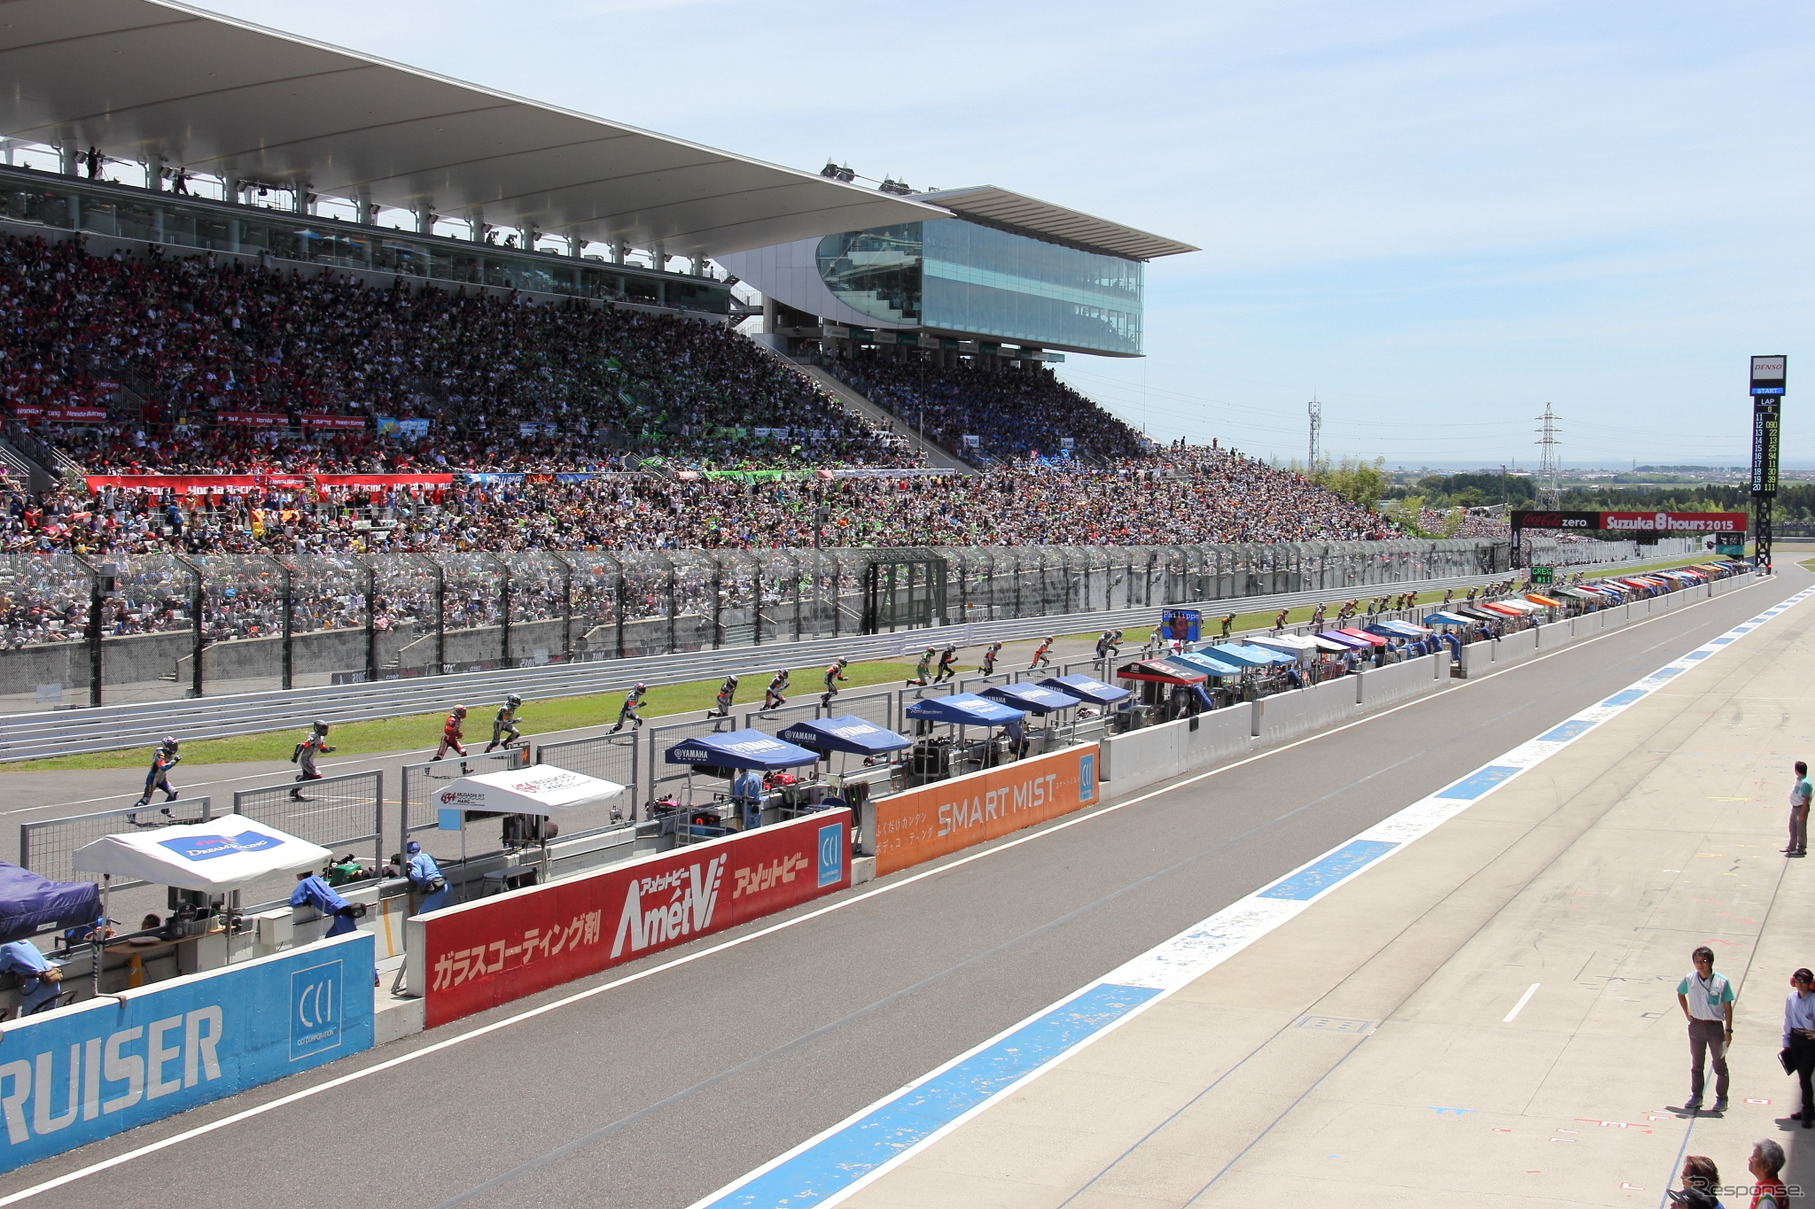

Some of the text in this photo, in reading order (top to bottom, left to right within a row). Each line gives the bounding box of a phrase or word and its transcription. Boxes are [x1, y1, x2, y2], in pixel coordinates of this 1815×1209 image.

[1756, 413, 1778, 421] 11 7
[1755, 421, 1778, 429] 12 090
[1755, 429, 1778, 437] 13 22
[1755, 437, 1763, 445] 14
[1768, 444, 1777, 452] 25
[1754, 452, 1776, 460] 16 94
[1754, 460, 1762, 468] 17
[1753, 468, 1776, 476] 18 30
[1753, 476, 1776, 484] 19 39
[1752, 483, 1775, 491] 20 111
[1562, 519, 1587, 527] zero
[1606, 513, 1734, 530] Suzuka 8 hours 2015
[1532, 567, 1552, 575] GREG
[1163, 610, 1200, 620] Philippe
[792, 731, 817, 741] YAMAHA
[682, 749, 708, 758] YAMAHA
[937, 774, 1057, 837] SMART MIST
[822, 835, 839, 867] CCI
[733, 852, 809, 899] アメットビー
[640, 867, 691, 897] アメットビー
[610, 852, 728, 959] AmétVi
[432, 908, 602, 992] ガラスコーティング剤
[299, 979, 332, 1028] CCI
[0, 1005, 223, 1145] RUISER
